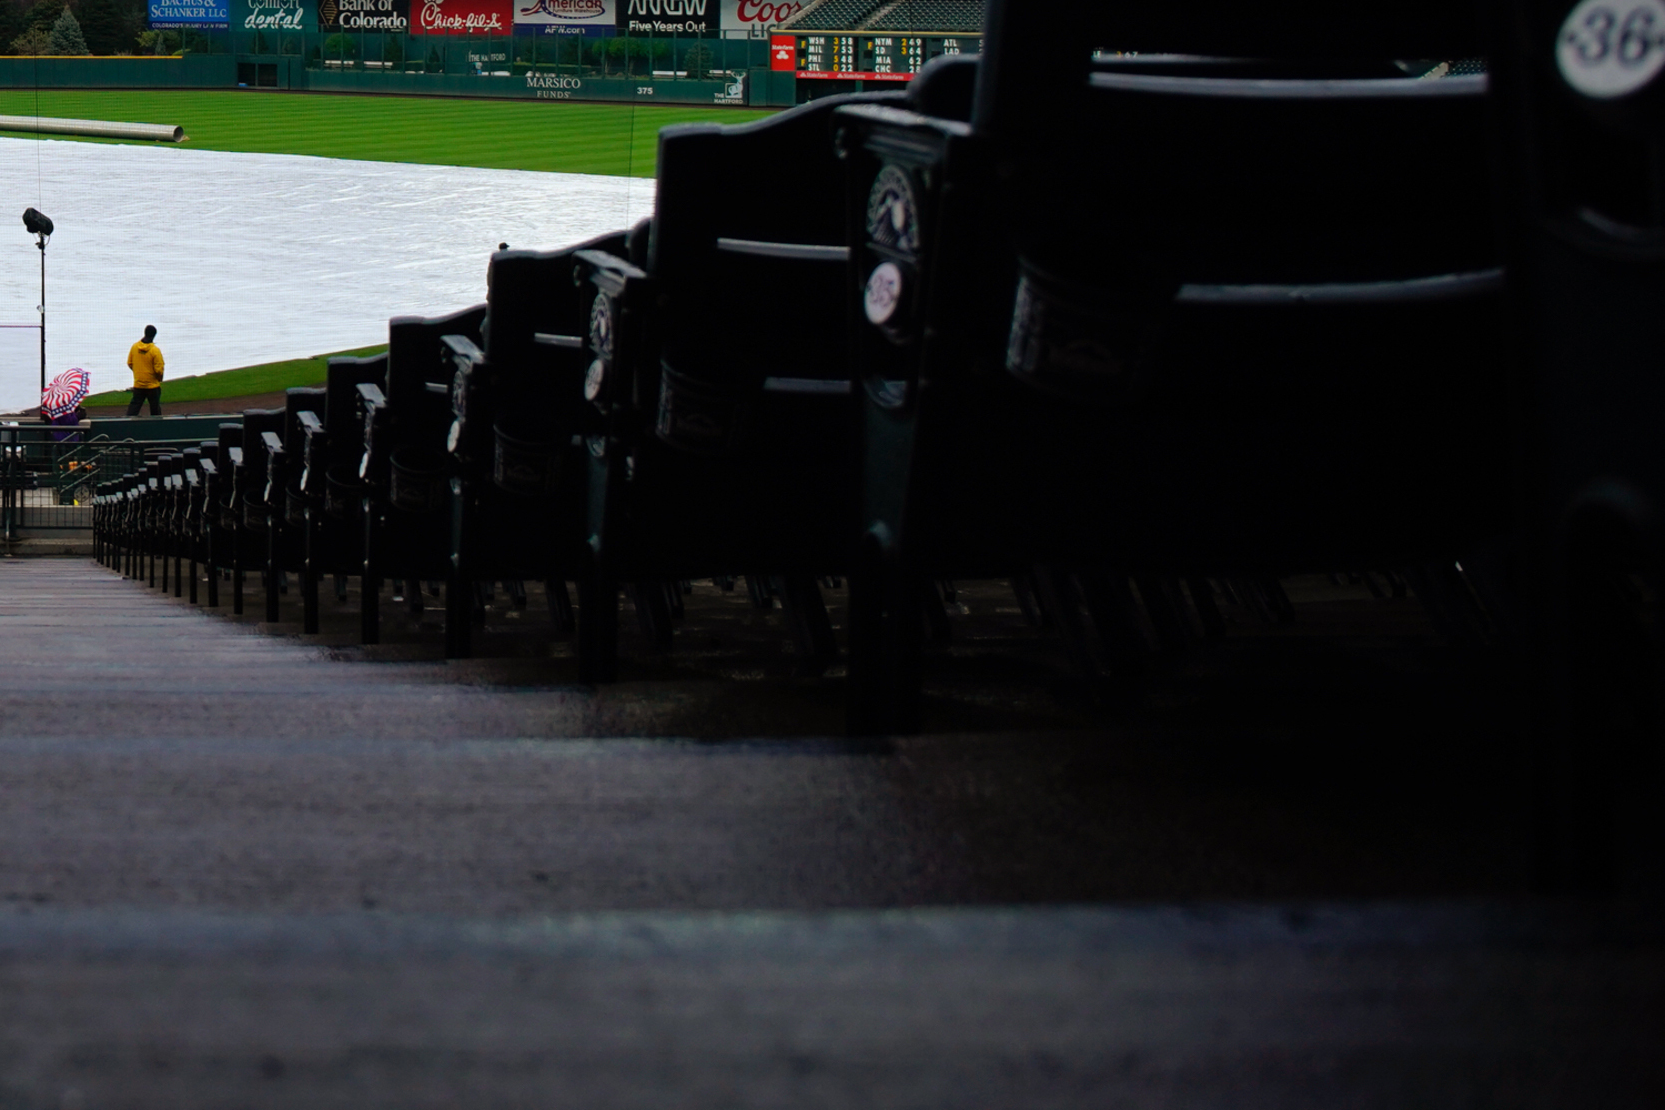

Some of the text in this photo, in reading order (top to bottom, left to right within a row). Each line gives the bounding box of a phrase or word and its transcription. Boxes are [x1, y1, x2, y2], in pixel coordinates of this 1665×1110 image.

[151, 5, 227, 18] SCHANKER LLC
[245, 8, 304, 30] dental
[339, 11, 407, 30] Colorado
[629, 20, 706, 32] Five Years Out
[1585, 6, 1657, 66] 36
[808, 37, 825, 45] WSH
[833, 37, 839, 45] 3
[875, 37, 893, 46] NYM
[901, 38, 907, 46] 2
[943, 39, 957, 47] ATL
[808, 46, 823, 54] MIL
[875, 46, 886, 54] SD
[901, 47, 907, 55] 3
[833, 55, 839, 63] 5
[876, 56, 891, 64] MIA
[808, 63, 820, 72] STL
[833, 63, 839, 71] 0
[875, 65, 891, 73] CHC
[526, 77, 581, 89] MARSICO
[537, 90, 570, 99] FUNDS
[637, 87, 653, 95] 375
